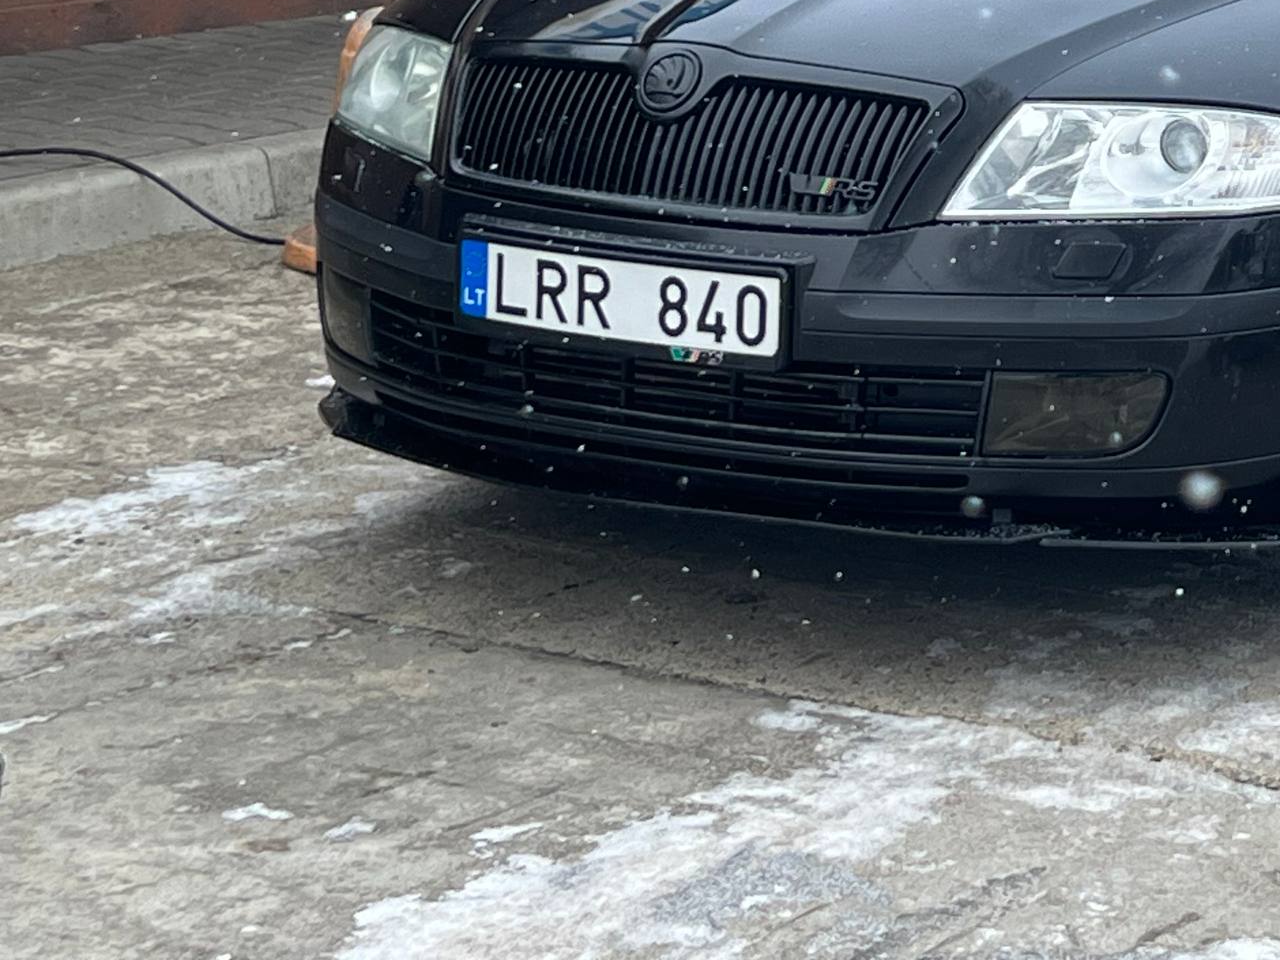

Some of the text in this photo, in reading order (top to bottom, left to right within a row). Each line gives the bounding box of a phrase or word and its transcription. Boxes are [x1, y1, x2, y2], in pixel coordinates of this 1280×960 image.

[463, 252, 768, 347] LT LRR 840
